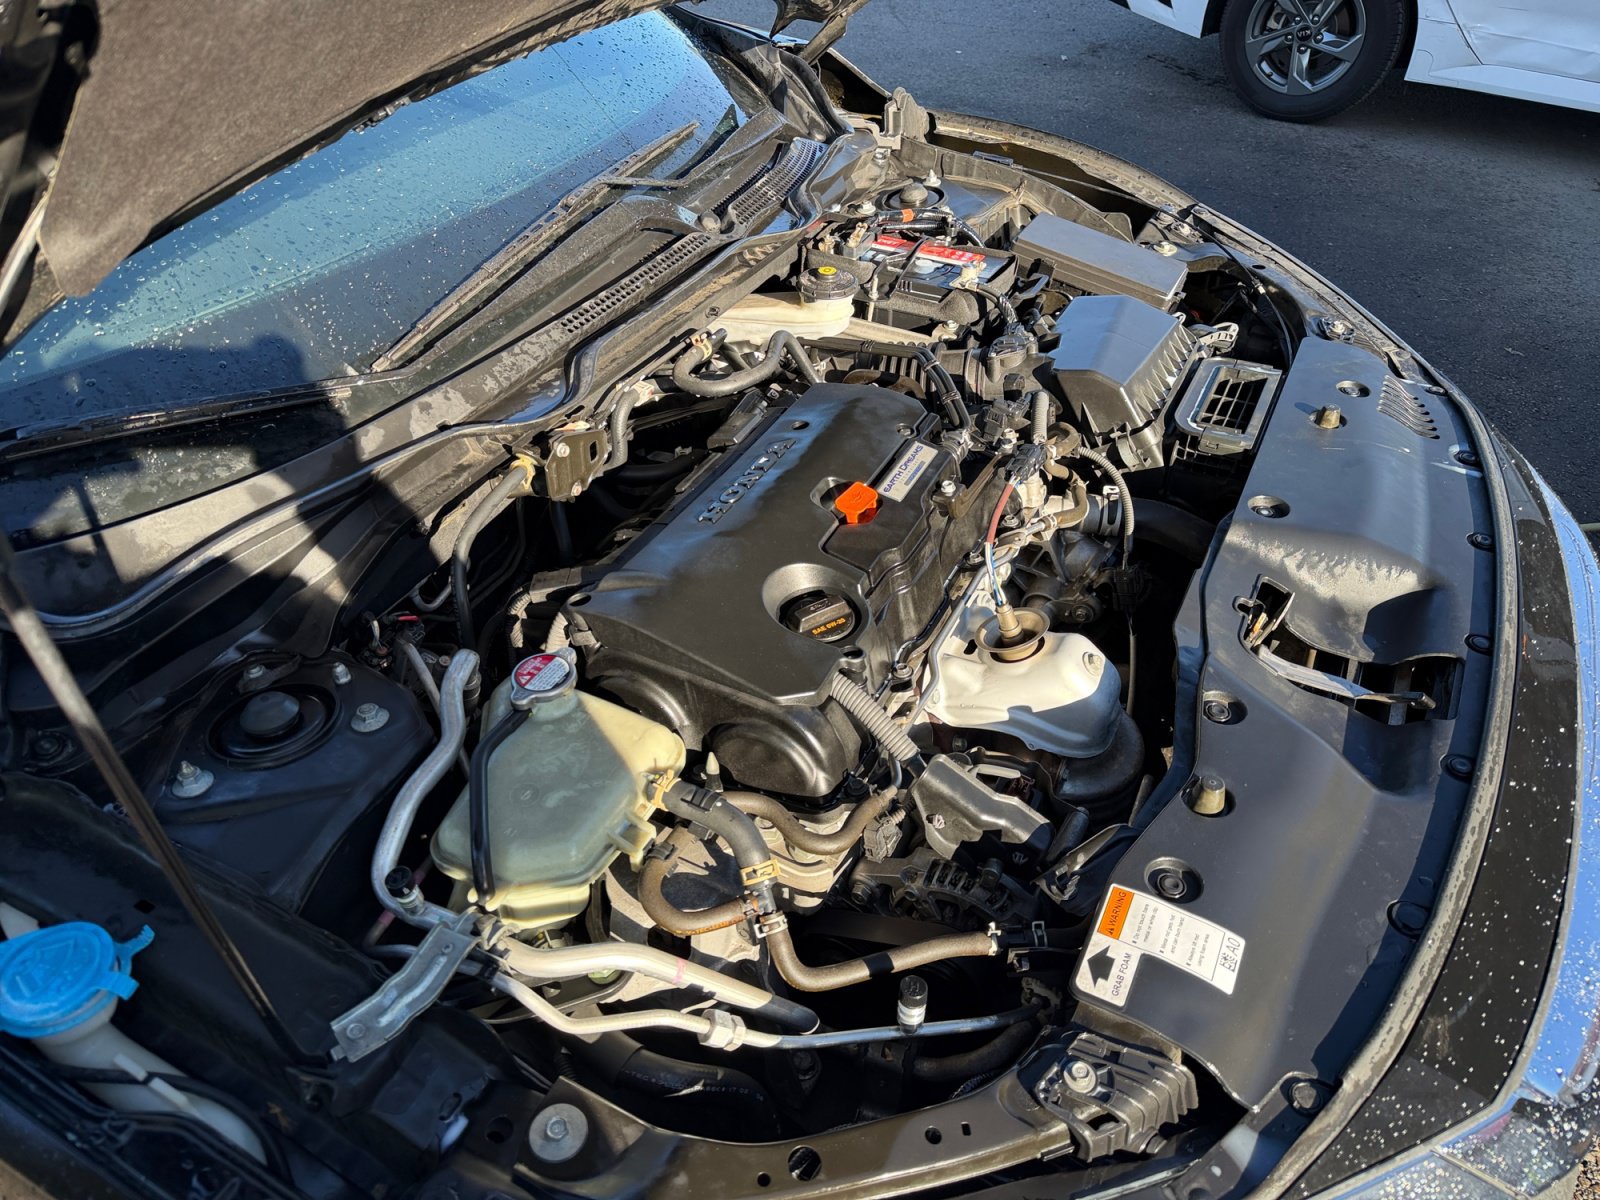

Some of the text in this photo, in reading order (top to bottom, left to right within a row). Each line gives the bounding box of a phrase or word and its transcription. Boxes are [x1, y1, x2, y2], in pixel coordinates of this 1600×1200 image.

[697, 439, 796, 524] HONDA
[884, 471, 903, 492] EARTH
[900, 445, 922, 471] DREAMS
[812, 626, 826, 634] SAE
[1113, 891, 1126, 928] WARNING
[1112, 953, 1131, 996] GRAB FOAM
